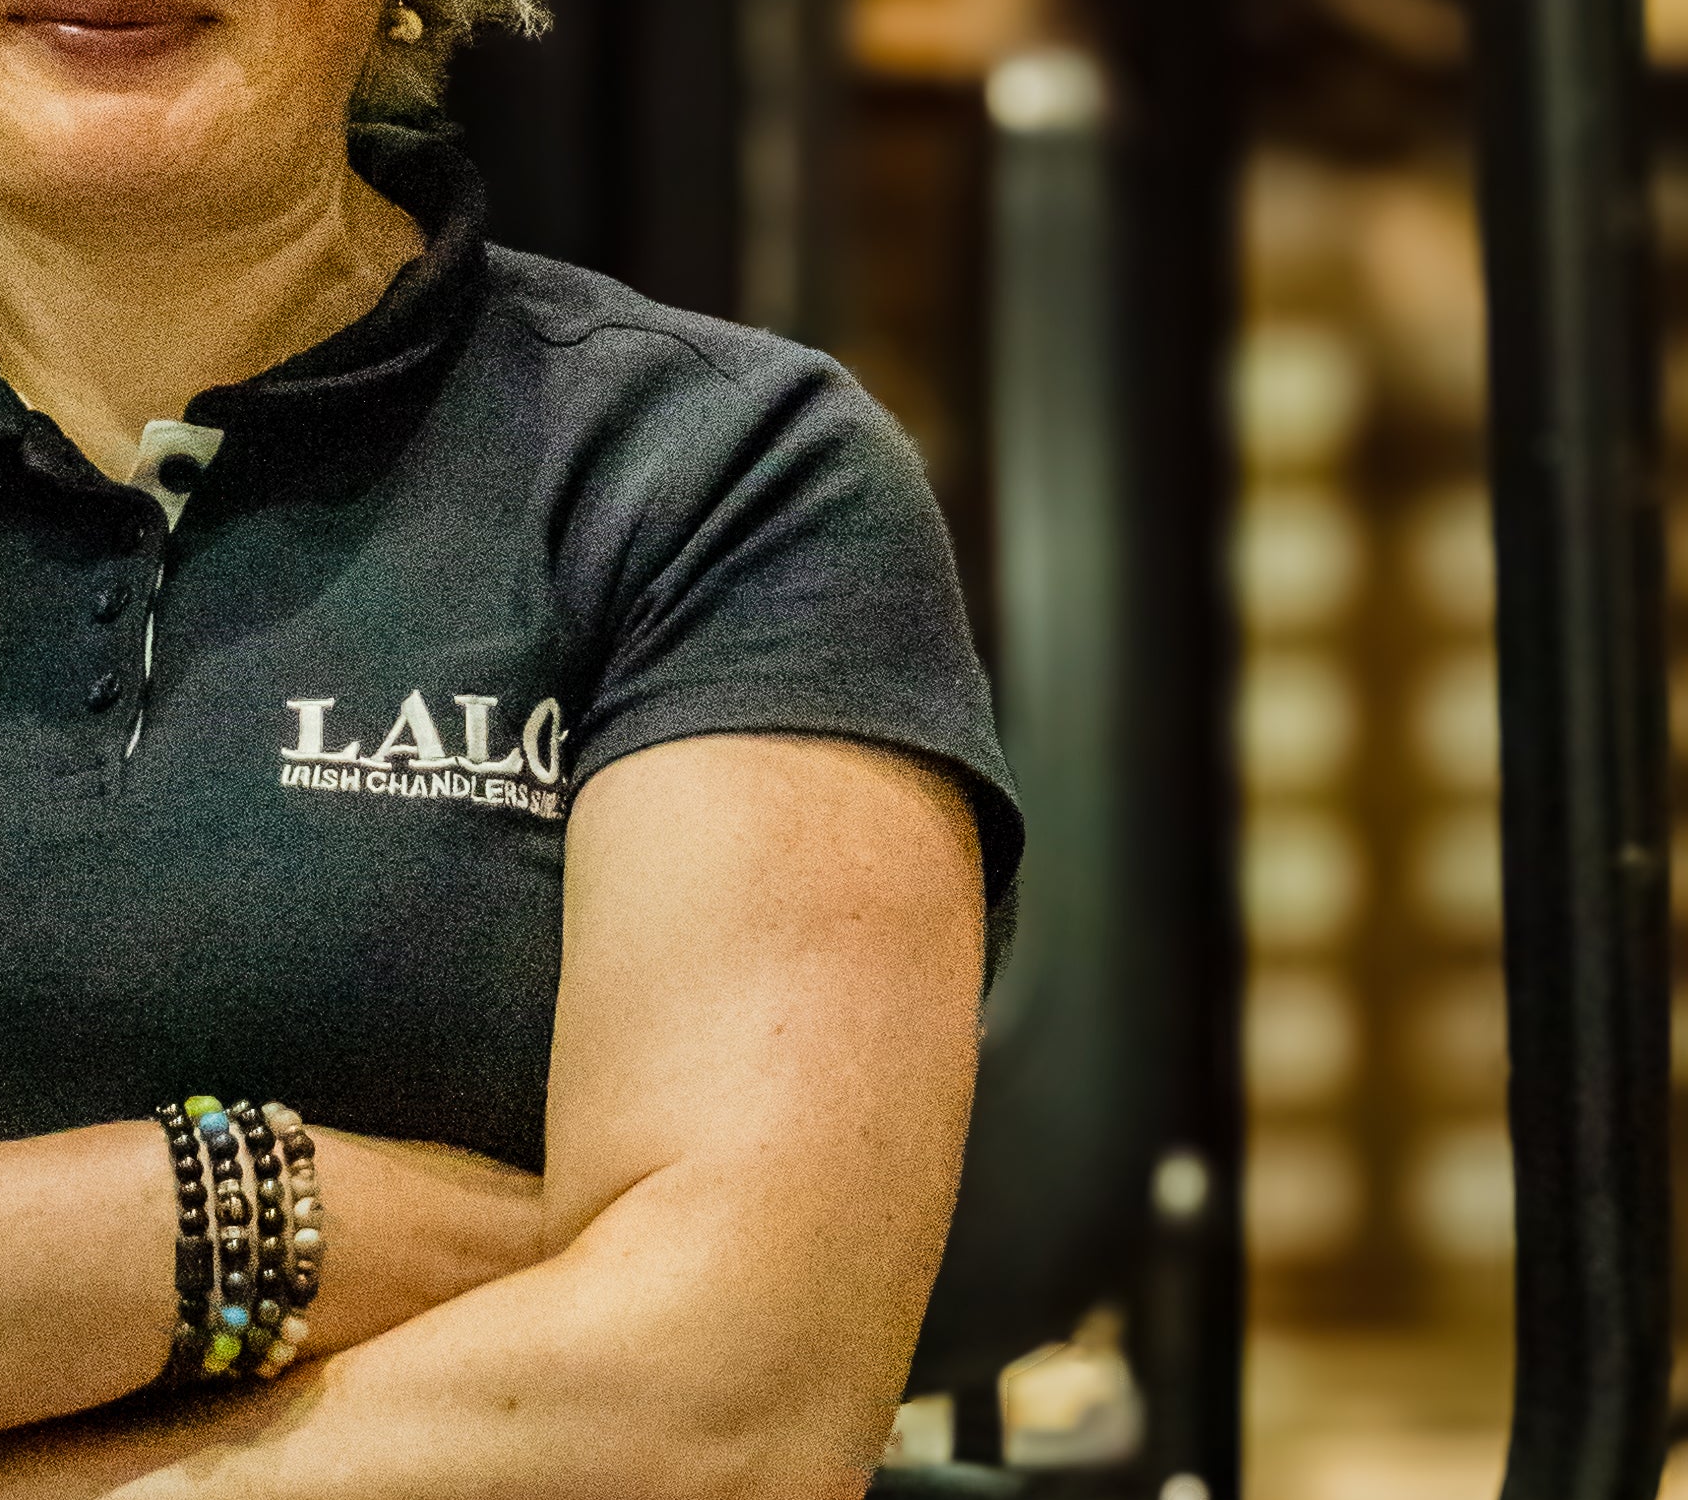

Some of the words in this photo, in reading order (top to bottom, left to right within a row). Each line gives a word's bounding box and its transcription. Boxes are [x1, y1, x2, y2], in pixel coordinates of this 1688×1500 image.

[280, 688, 568, 784] LALO
[280, 763, 361, 791] IRISH
[366, 769, 528, 810] CHANDLERS
